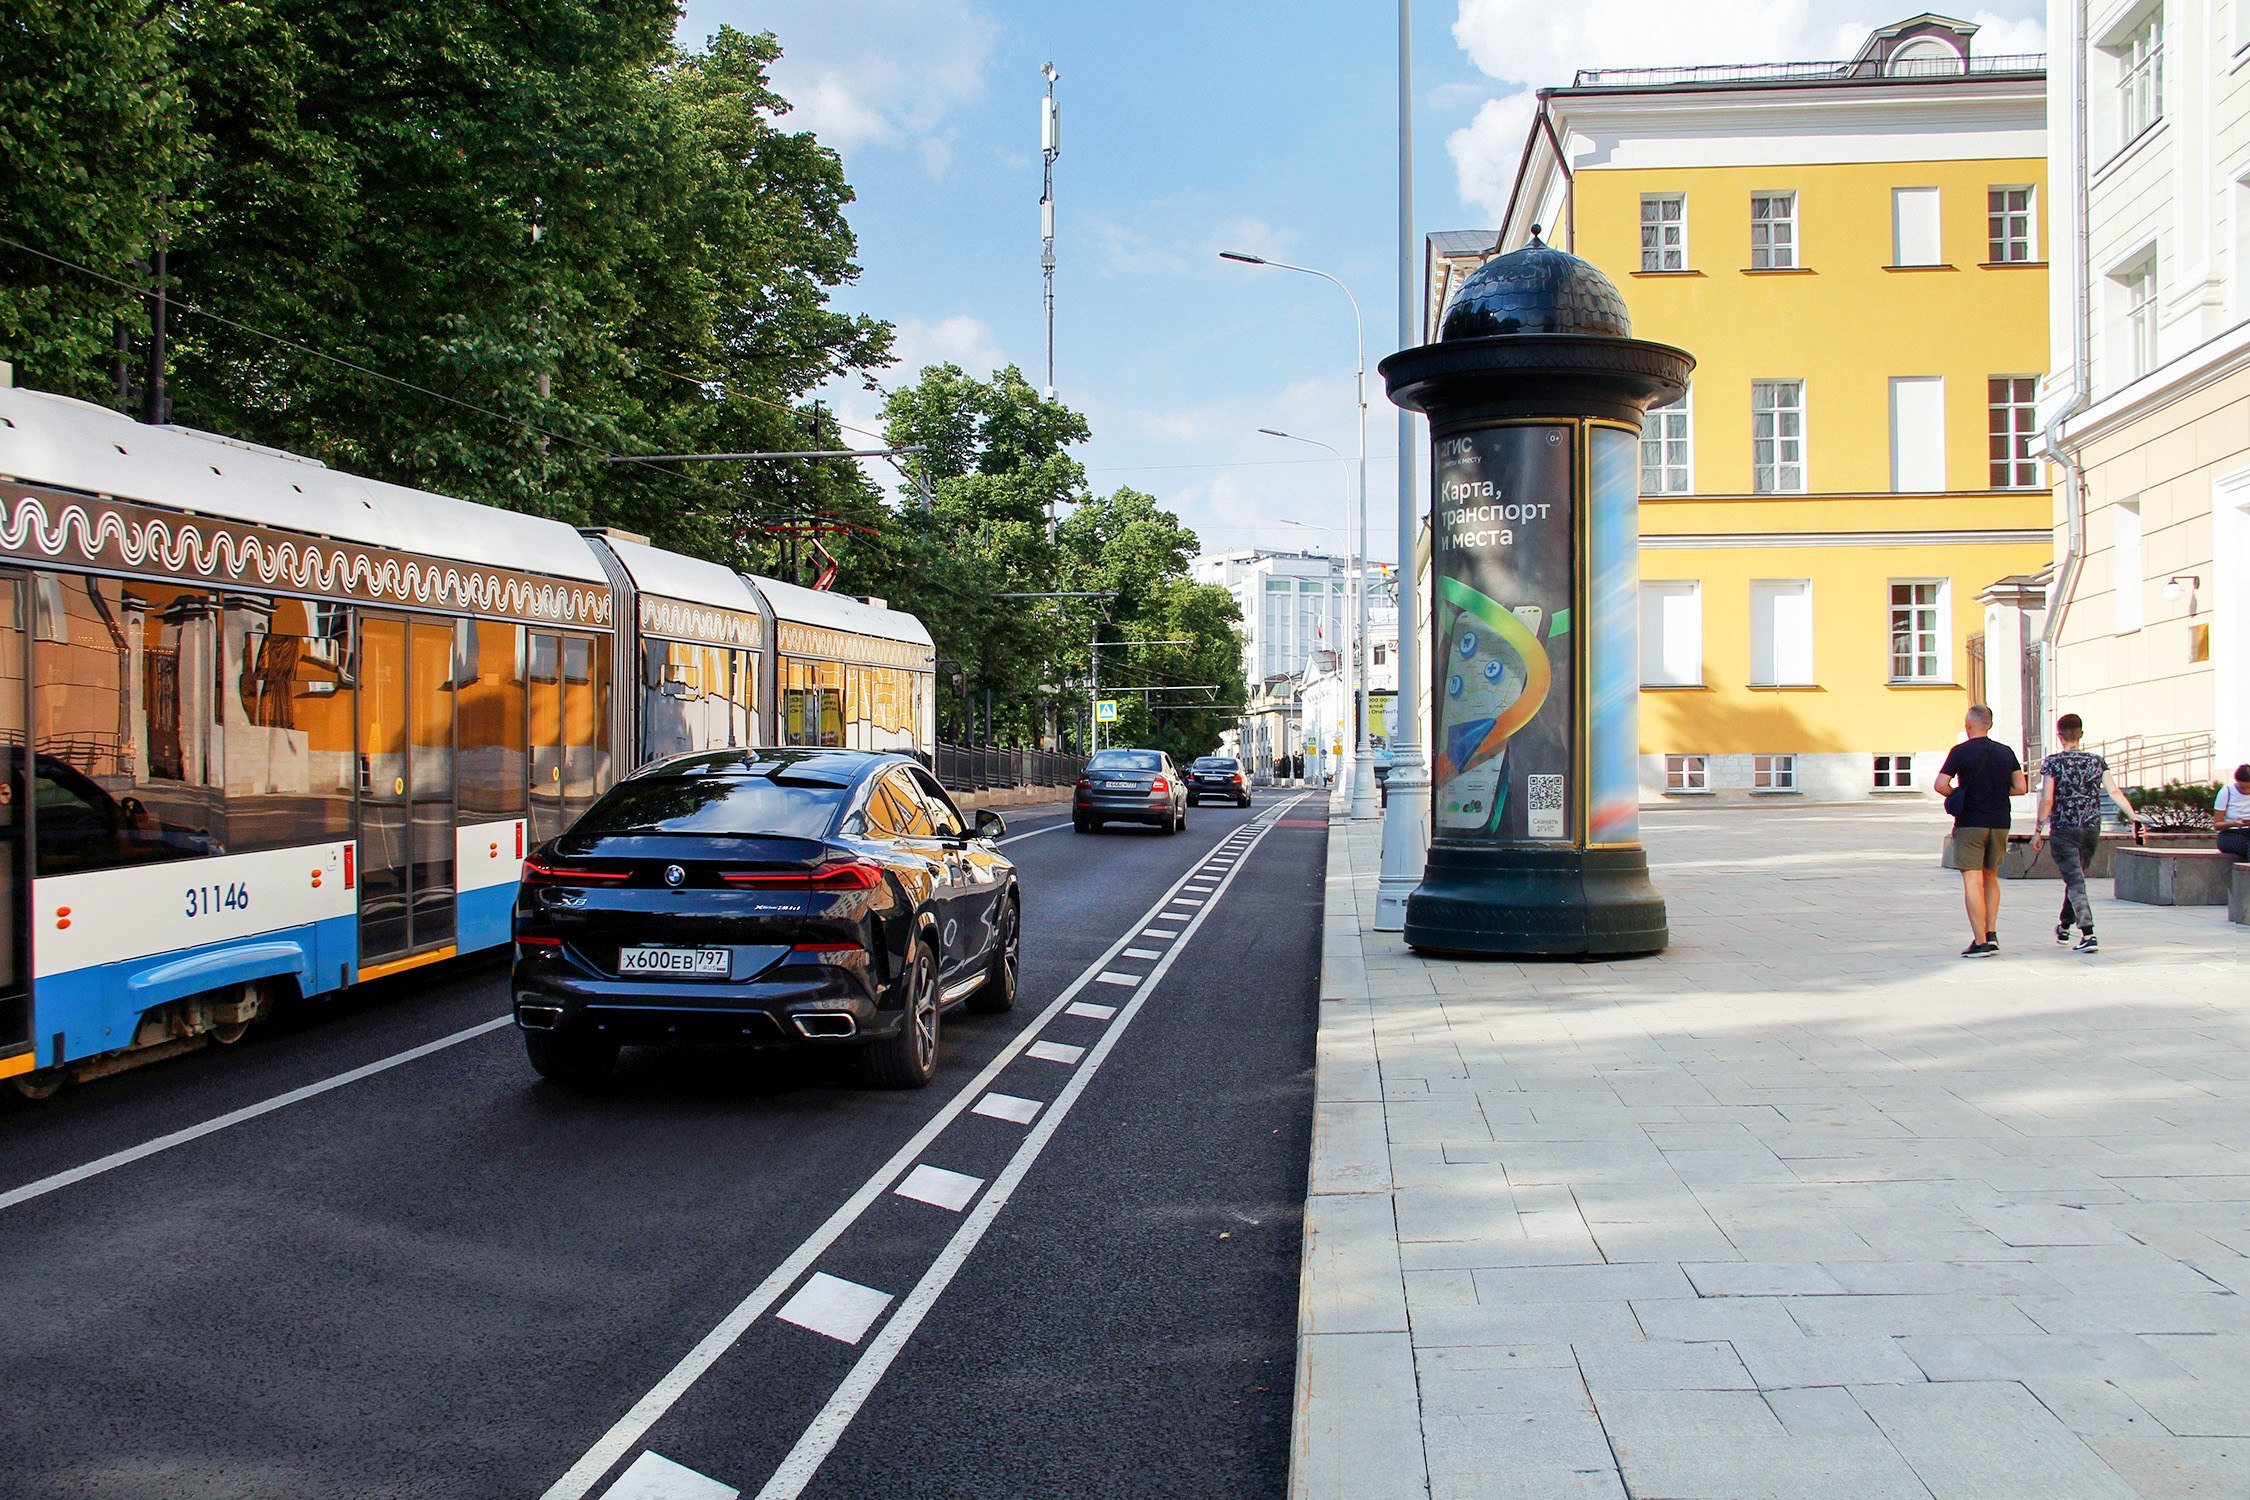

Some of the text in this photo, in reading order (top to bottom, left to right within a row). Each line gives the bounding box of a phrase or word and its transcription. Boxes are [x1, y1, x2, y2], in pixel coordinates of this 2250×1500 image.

[1442, 437, 1472, 457] 2ГИС
[1462, 456, 1482, 465] месту
[1441, 480, 1502, 504] Карта,
[1441, 503, 1551, 530] транспорт
[1441, 529, 1513, 551] и места
[185, 881, 249, 918] 31146
[697, 951, 724, 965] 797
